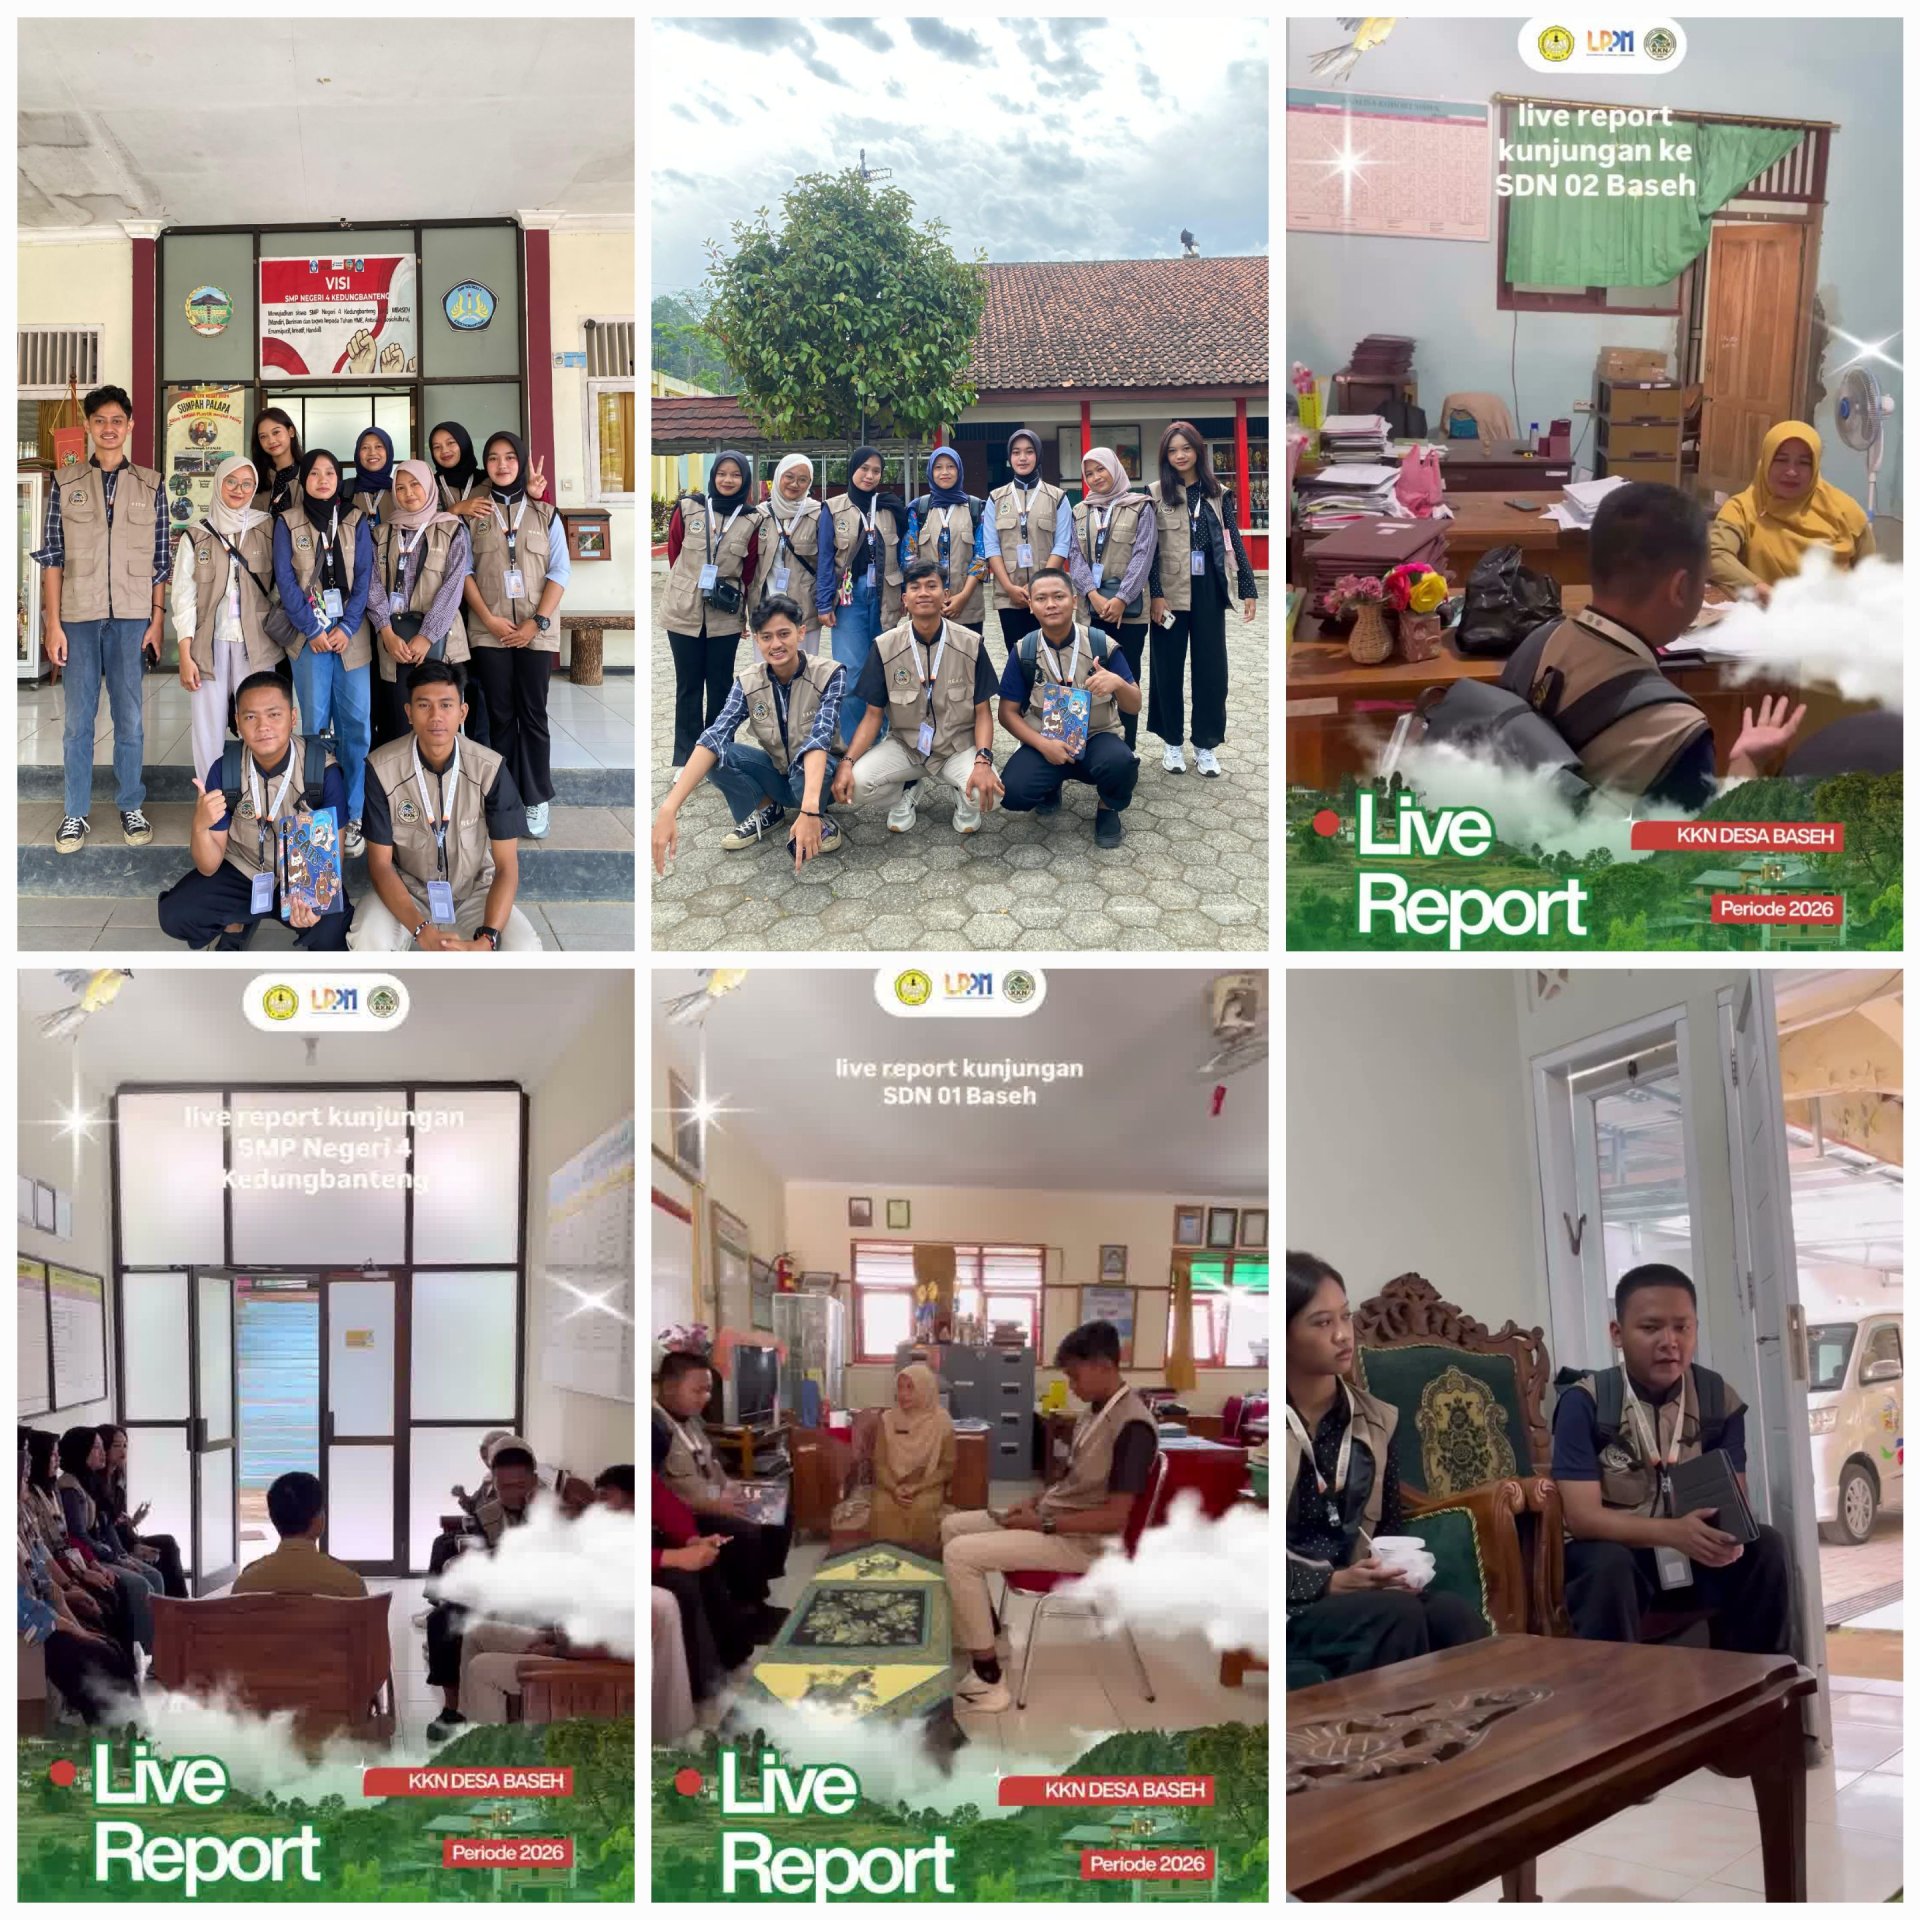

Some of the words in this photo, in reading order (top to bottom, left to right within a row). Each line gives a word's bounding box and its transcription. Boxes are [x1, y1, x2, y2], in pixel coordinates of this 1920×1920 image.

[325, 276, 350, 291] VISI
[300, 293, 325, 302] NEGERI
[331, 292, 390, 301] KEDUNGBANTENG
[176, 399, 204, 414] SUMPAH
[205, 399, 231, 414] PALAPA
